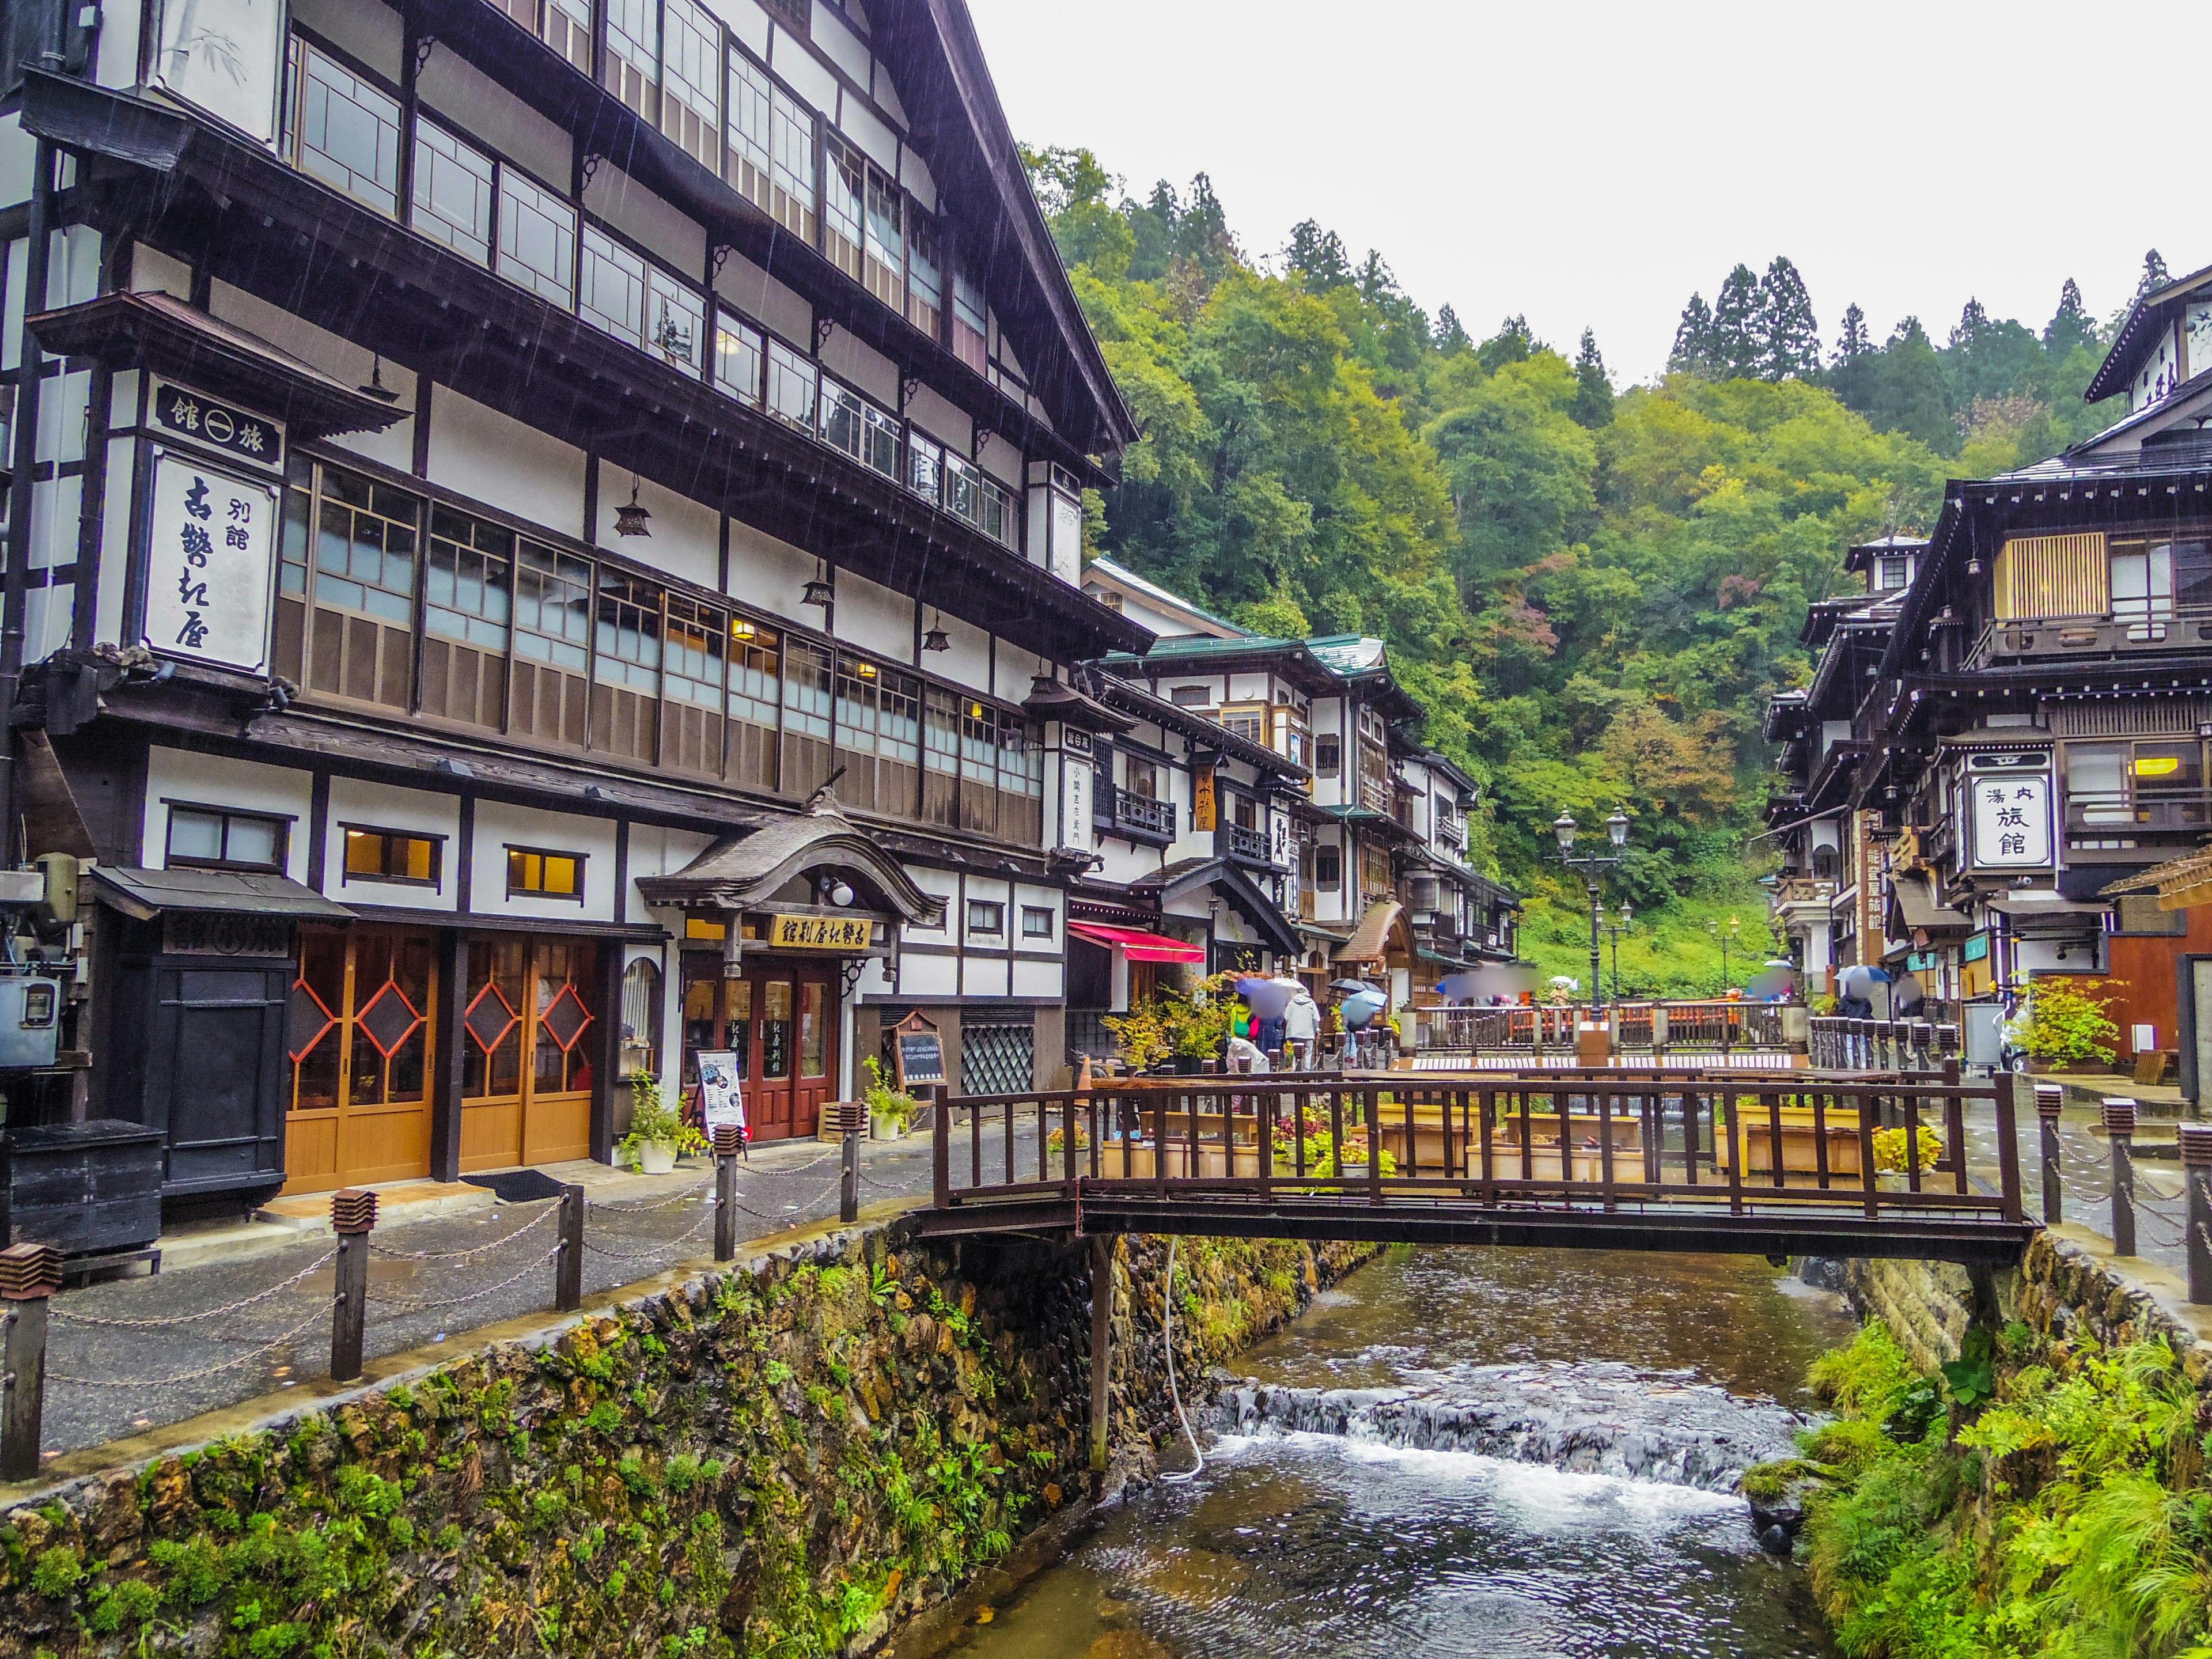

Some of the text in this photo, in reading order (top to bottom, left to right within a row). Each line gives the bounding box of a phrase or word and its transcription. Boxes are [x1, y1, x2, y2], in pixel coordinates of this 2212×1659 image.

[225, 498, 251, 551] 別館
[1995, 806, 2031, 856] 旅館
[1867, 849, 1882, 930] 能登屋旅館
